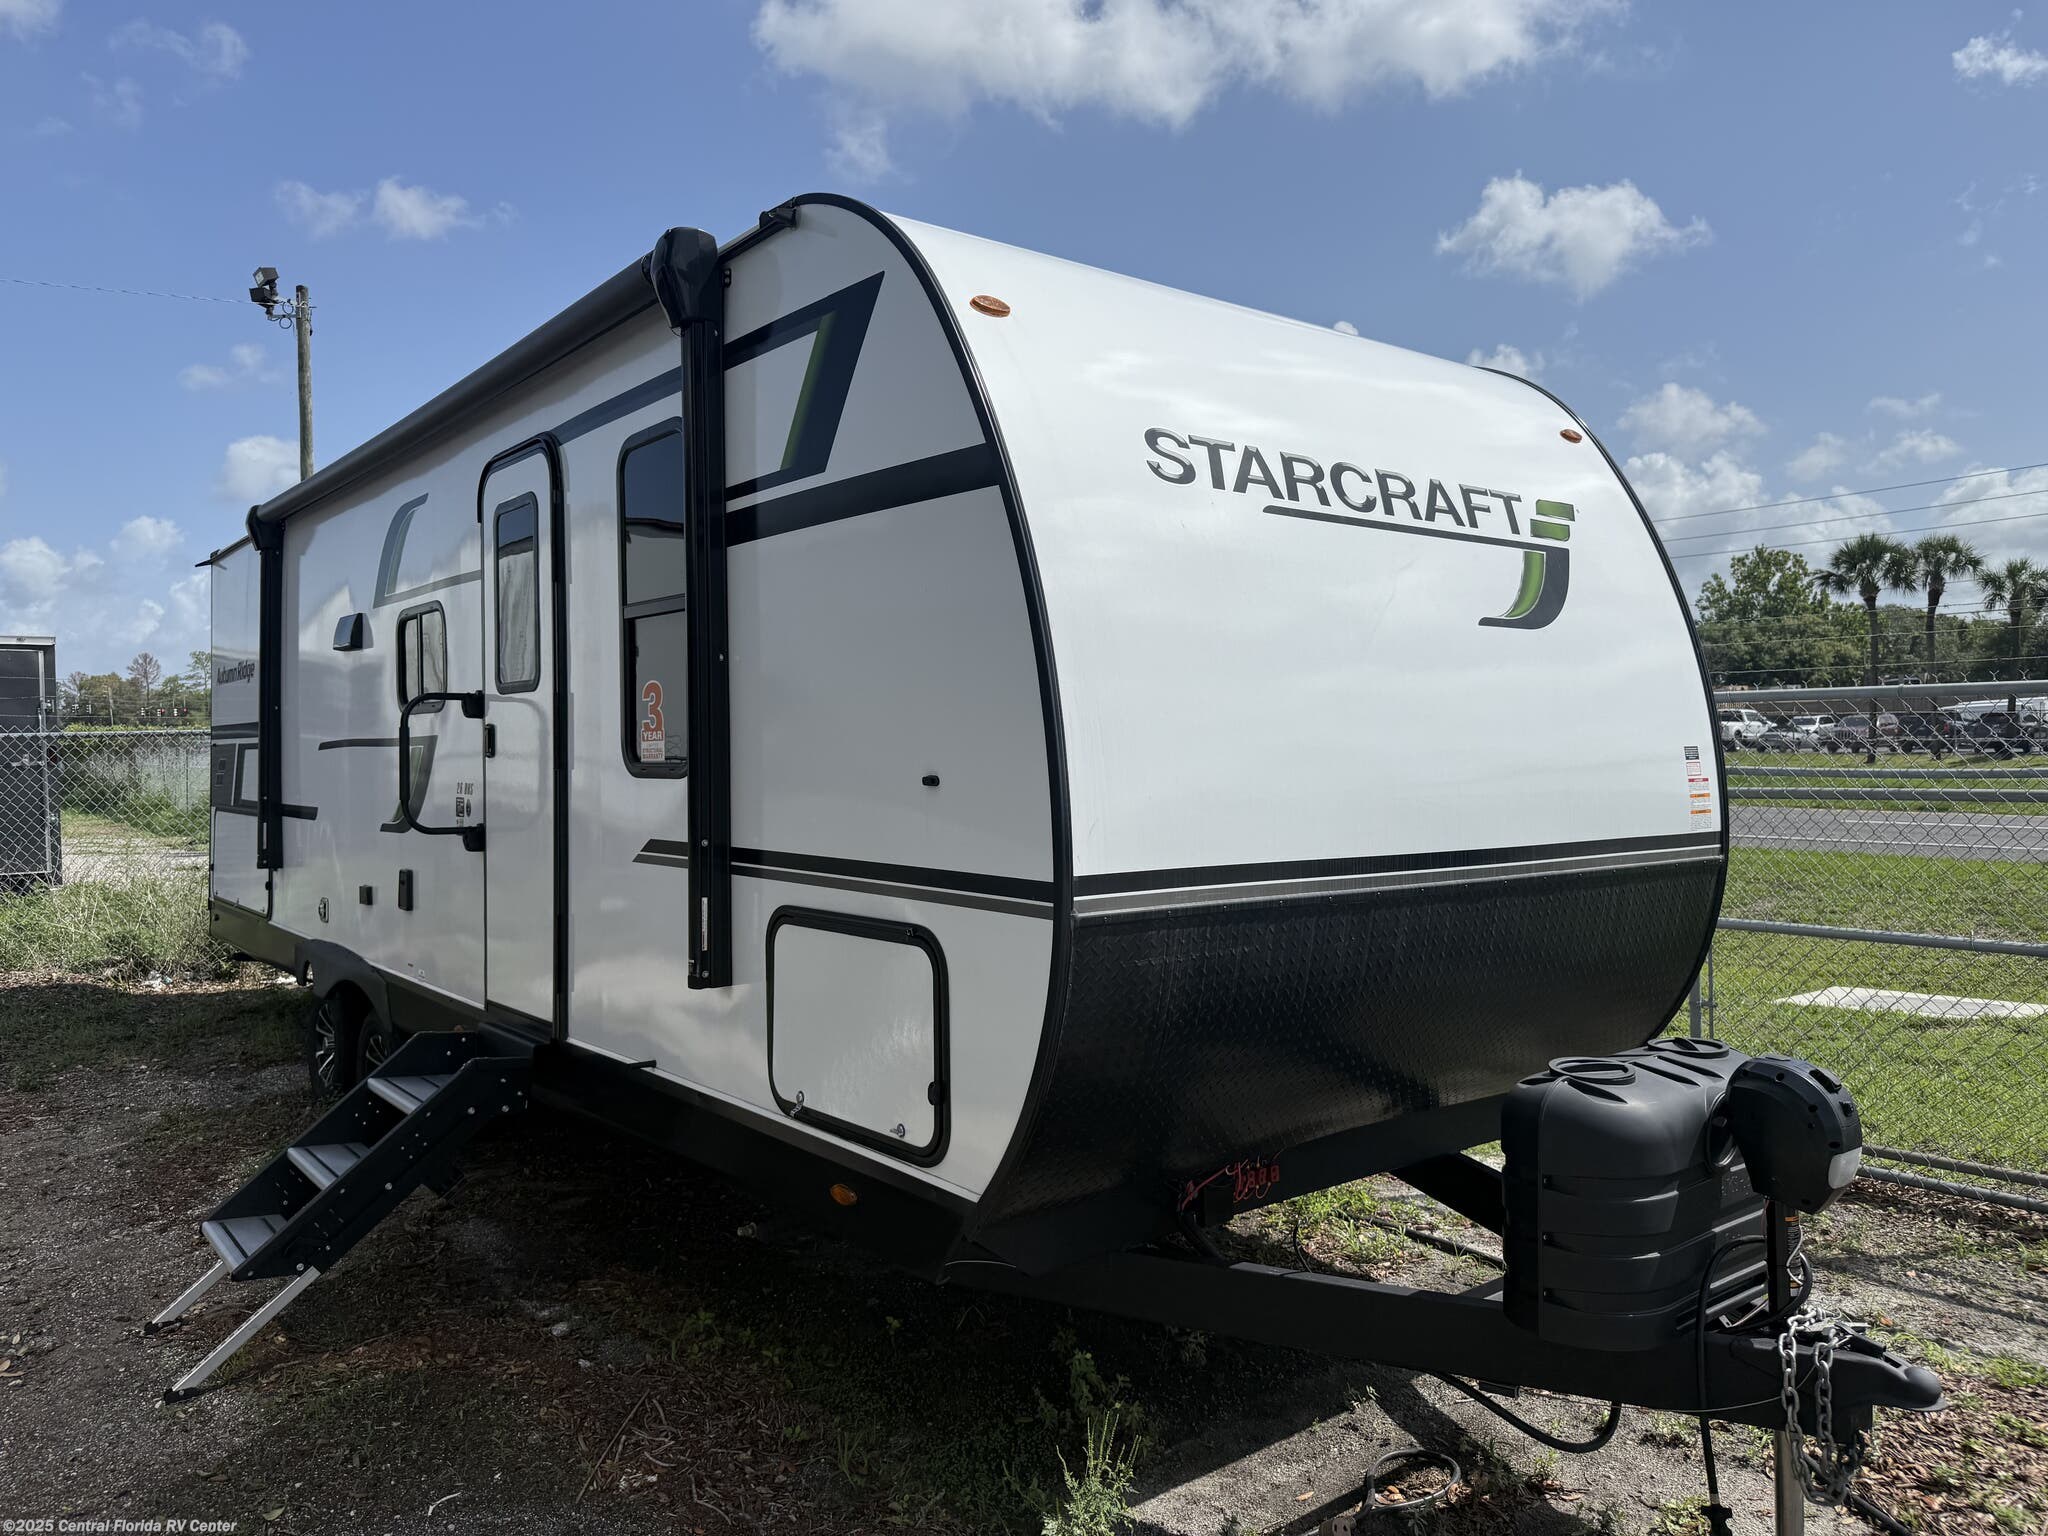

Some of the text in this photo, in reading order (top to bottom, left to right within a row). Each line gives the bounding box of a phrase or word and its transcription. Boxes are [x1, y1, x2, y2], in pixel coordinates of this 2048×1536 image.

[1144, 426, 1522, 535] STARCRAFT
[217, 660, 255, 685] Autumn Ridge
[642, 680, 664, 731] 3
[643, 731, 662, 741] YEAR
